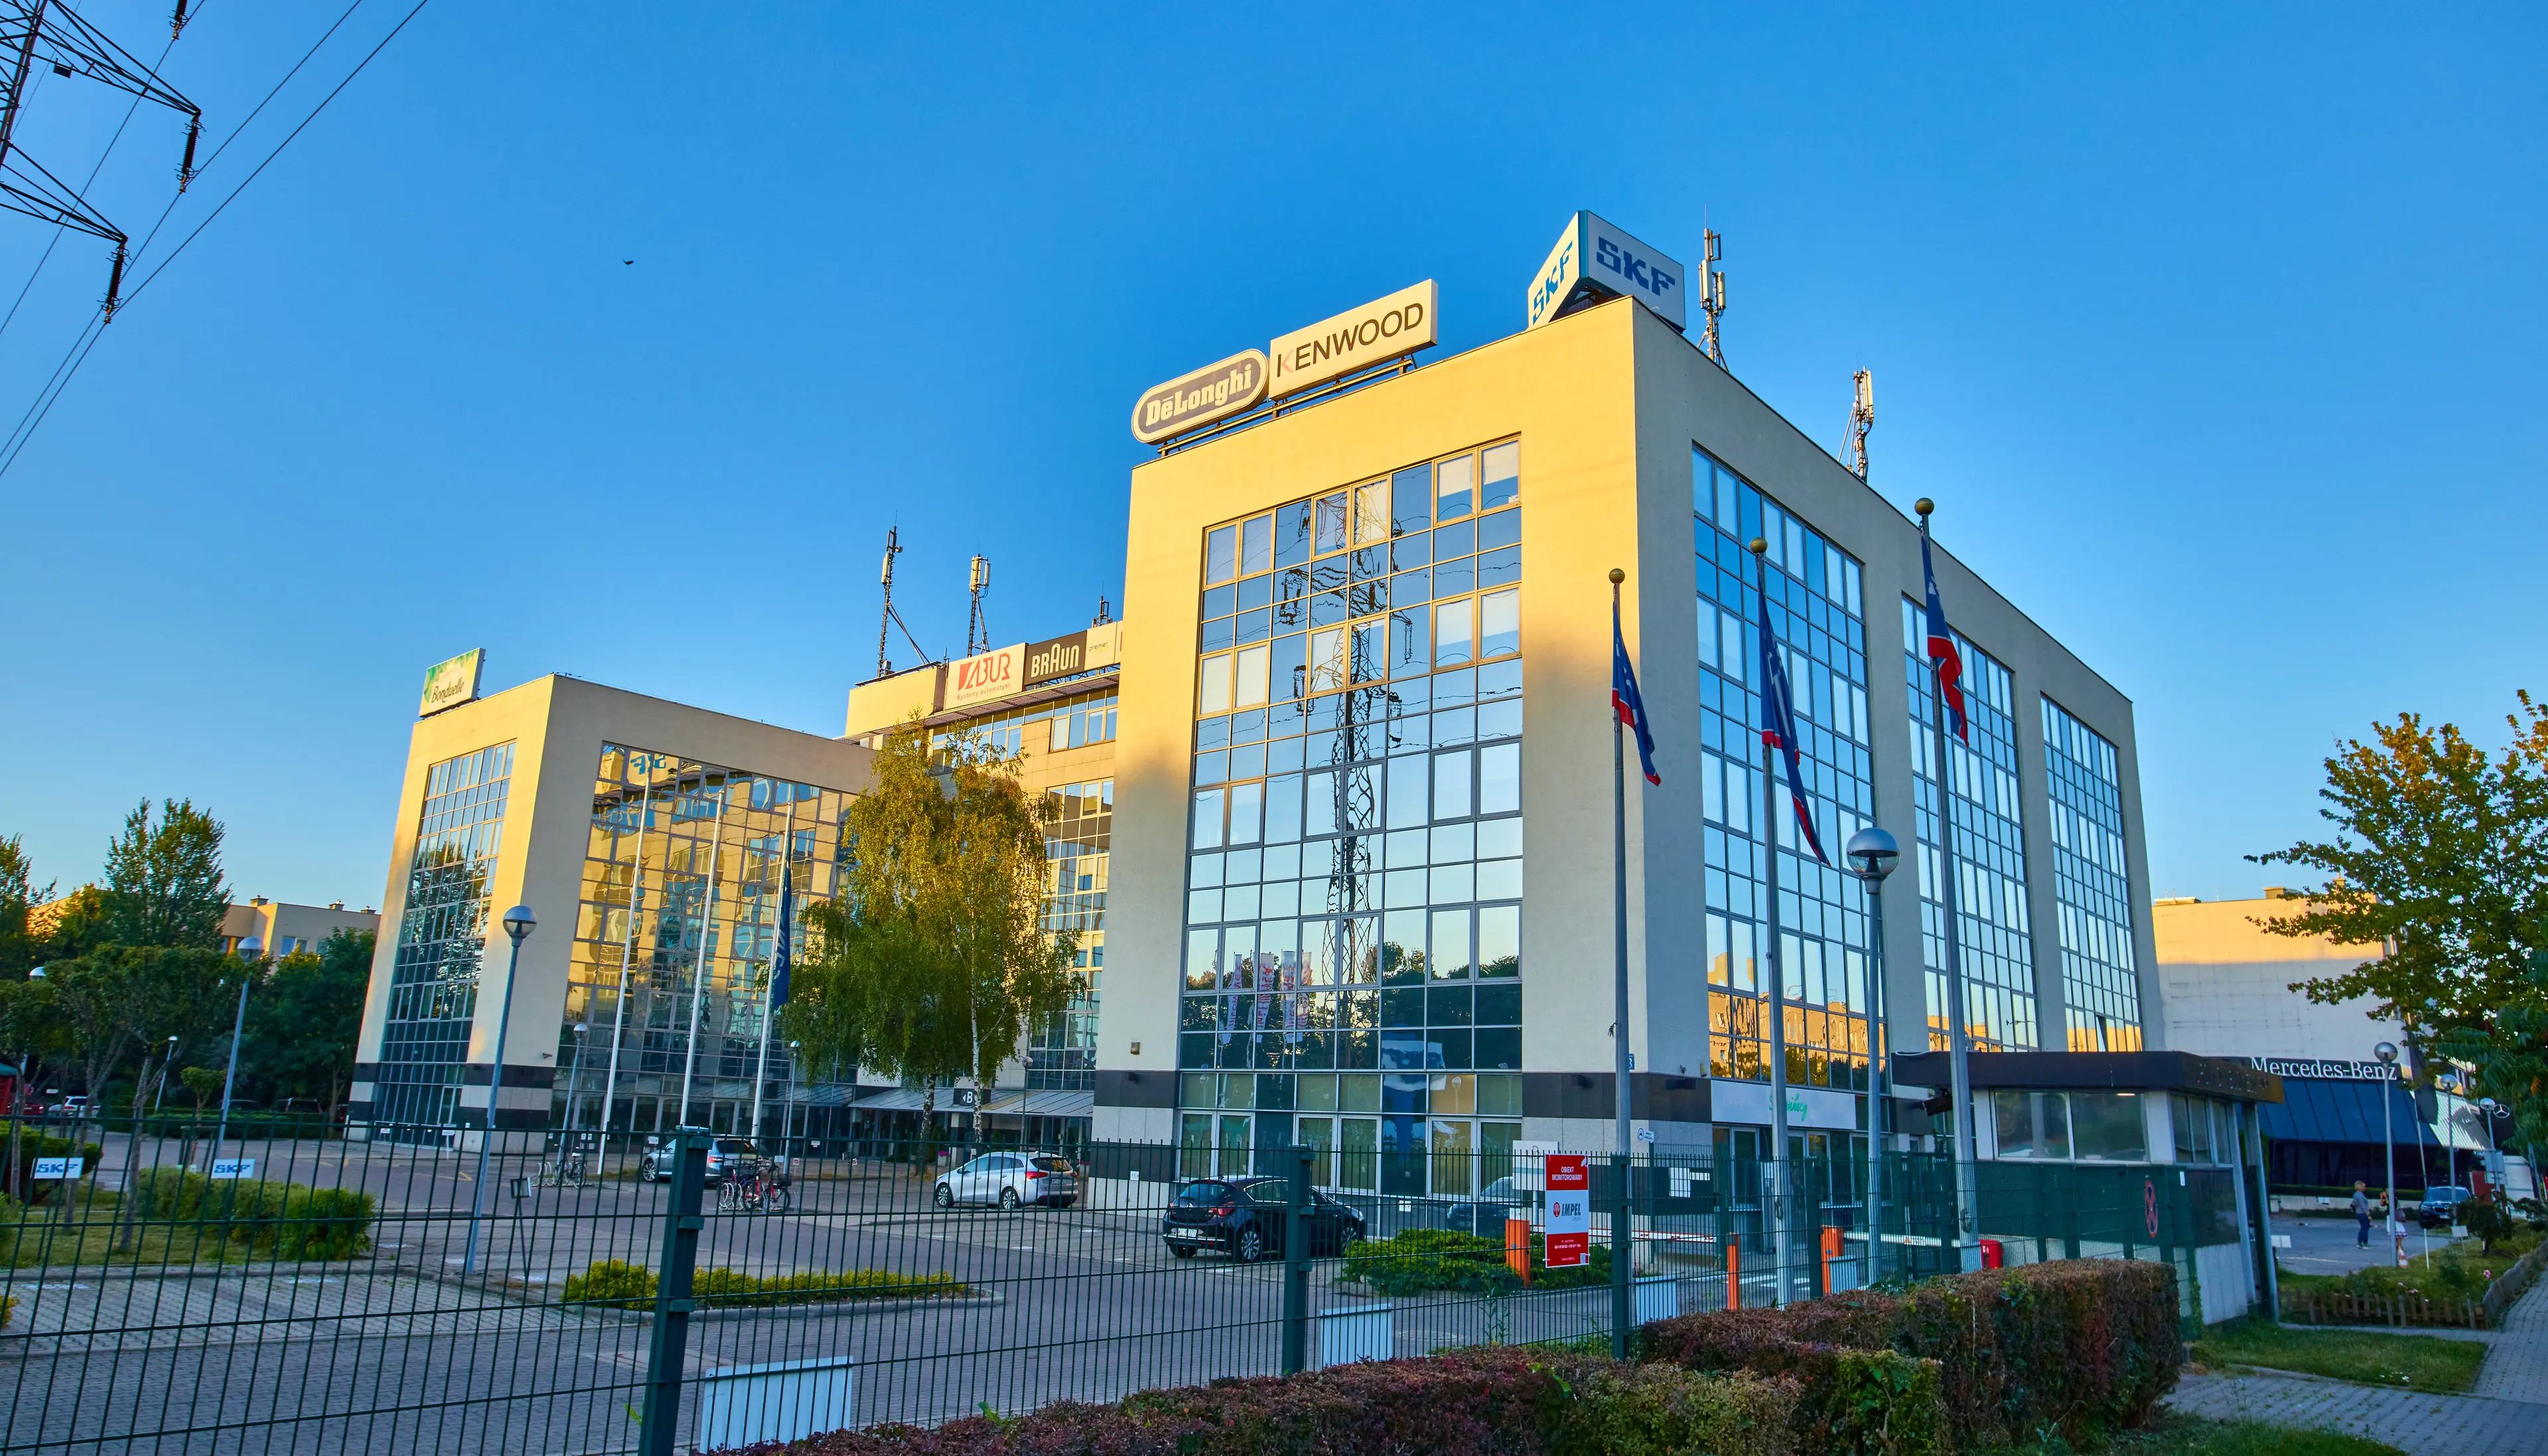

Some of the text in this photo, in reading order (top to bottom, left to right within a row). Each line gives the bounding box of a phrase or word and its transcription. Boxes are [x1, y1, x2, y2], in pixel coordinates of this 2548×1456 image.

[1596, 236, 1675, 297] SKF
[1533, 239, 1573, 326] SKF
[1277, 302, 1423, 377] KENWOOD
[1089, 642, 1108, 652] premier
[1030, 643, 1080, 678] BRAUN
[431, 677, 464, 703] Bonduelle
[957, 683, 1011, 700] Systemy automatyki
[2251, 1057, 2397, 1080] Mercedes-Benz
[966, 1091, 973, 1103] B
[36, 1164, 78, 1173] SKF
[1561, 1203, 1581, 1217] IMPEL
